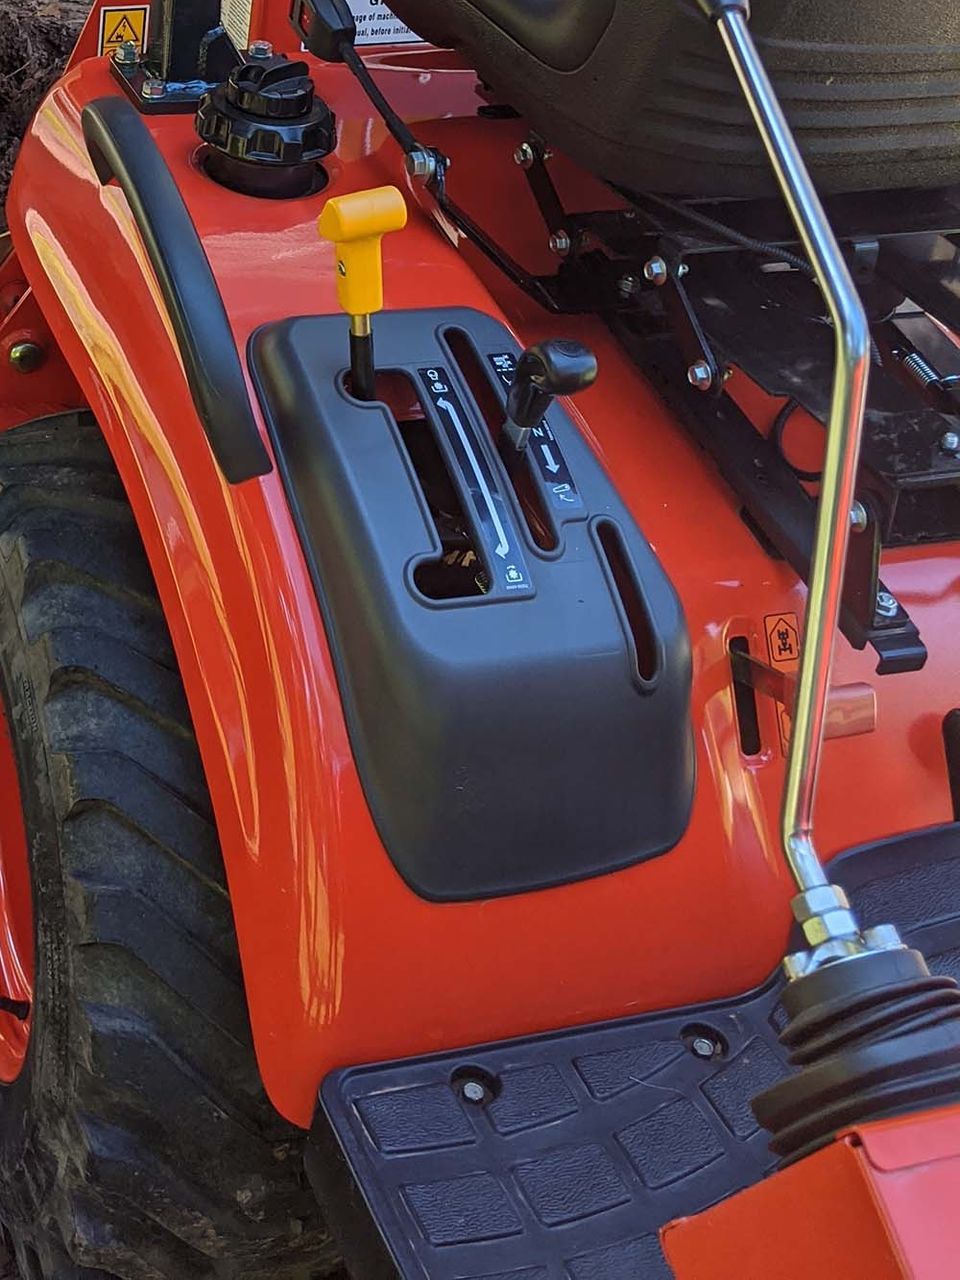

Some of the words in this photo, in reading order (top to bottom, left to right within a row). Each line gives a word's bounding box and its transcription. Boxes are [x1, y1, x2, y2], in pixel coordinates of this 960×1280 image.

[368, 12, 376, 21] of
[356, 27, 369, 37] ual,
[370, 27, 391, 36] before
[531, 427, 545, 438] N
